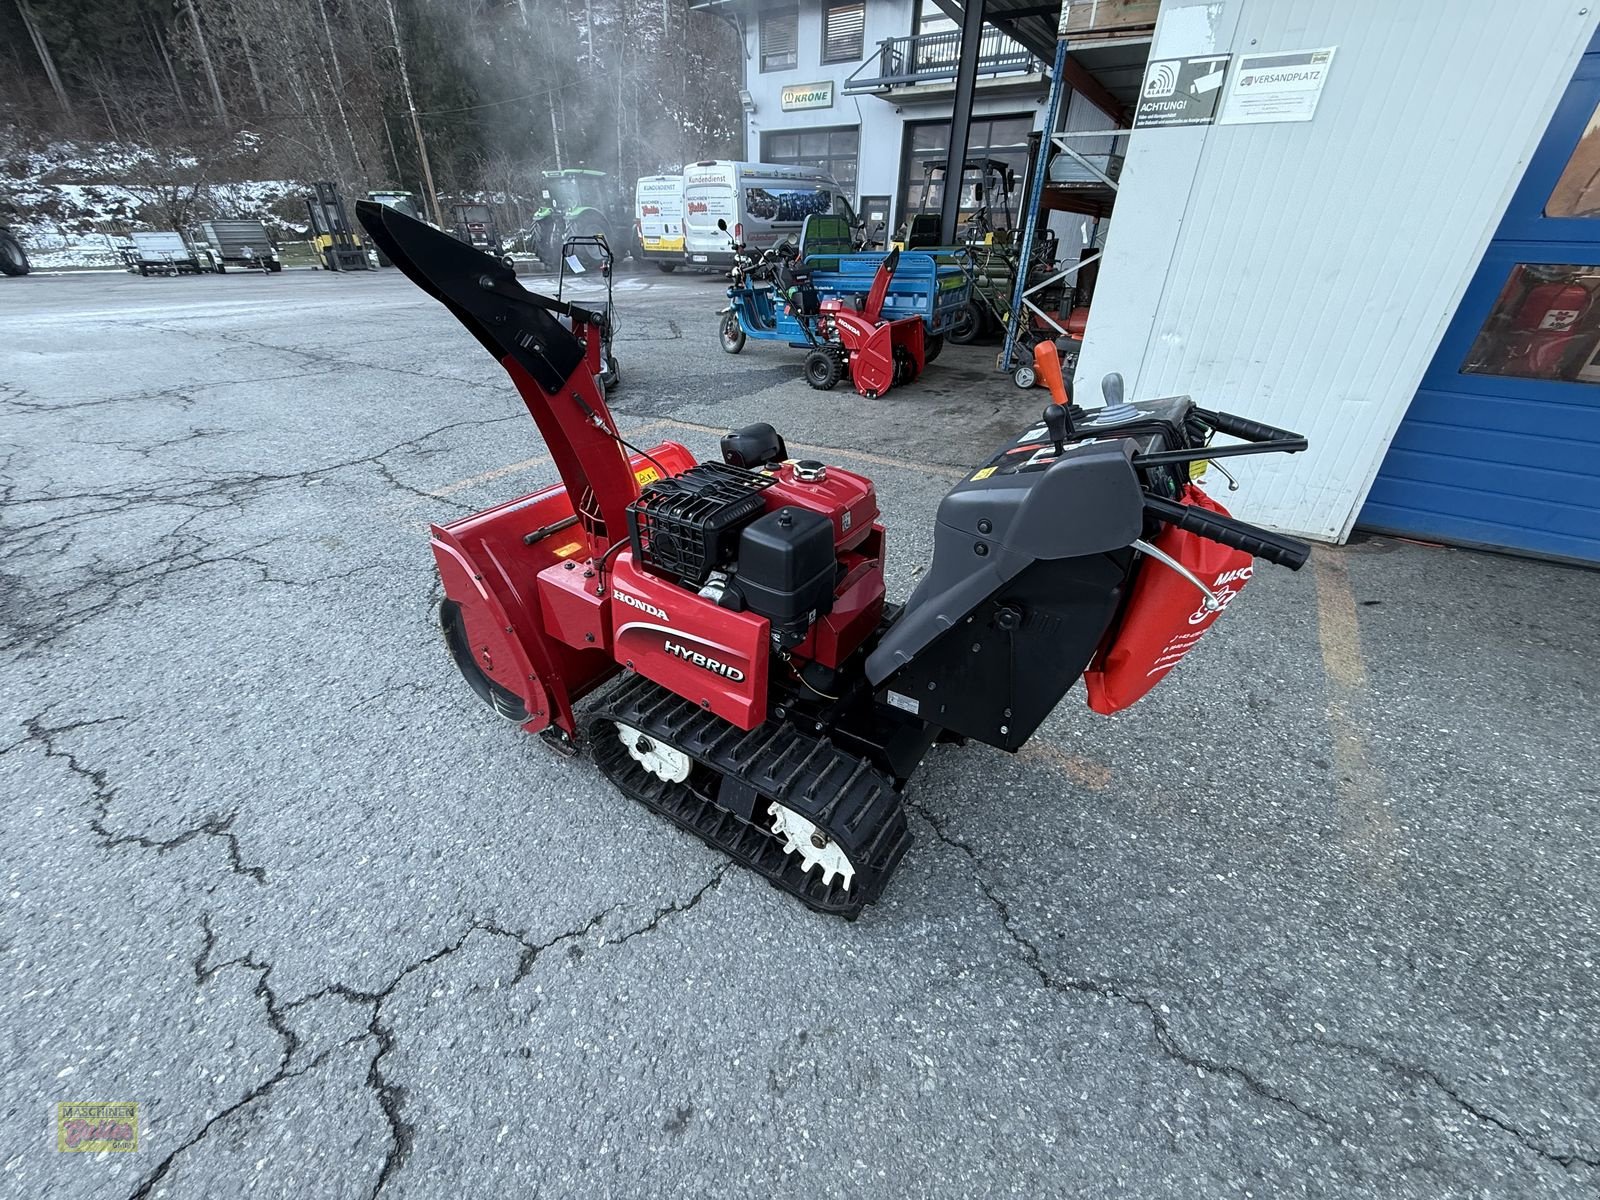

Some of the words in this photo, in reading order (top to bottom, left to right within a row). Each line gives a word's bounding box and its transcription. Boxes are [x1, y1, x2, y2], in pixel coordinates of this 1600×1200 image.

[1254, 71, 1320, 84] VERSANDPLATZ
[794, 92, 828, 103] KRONE
[1140, 100, 1188, 112] ACHTUNG!
[688, 175, 726, 184] Kundendienst
[838, 318, 860, 336] HONDA
[613, 589, 670, 622] HONDA
[664, 640, 745, 682] HYBRID
